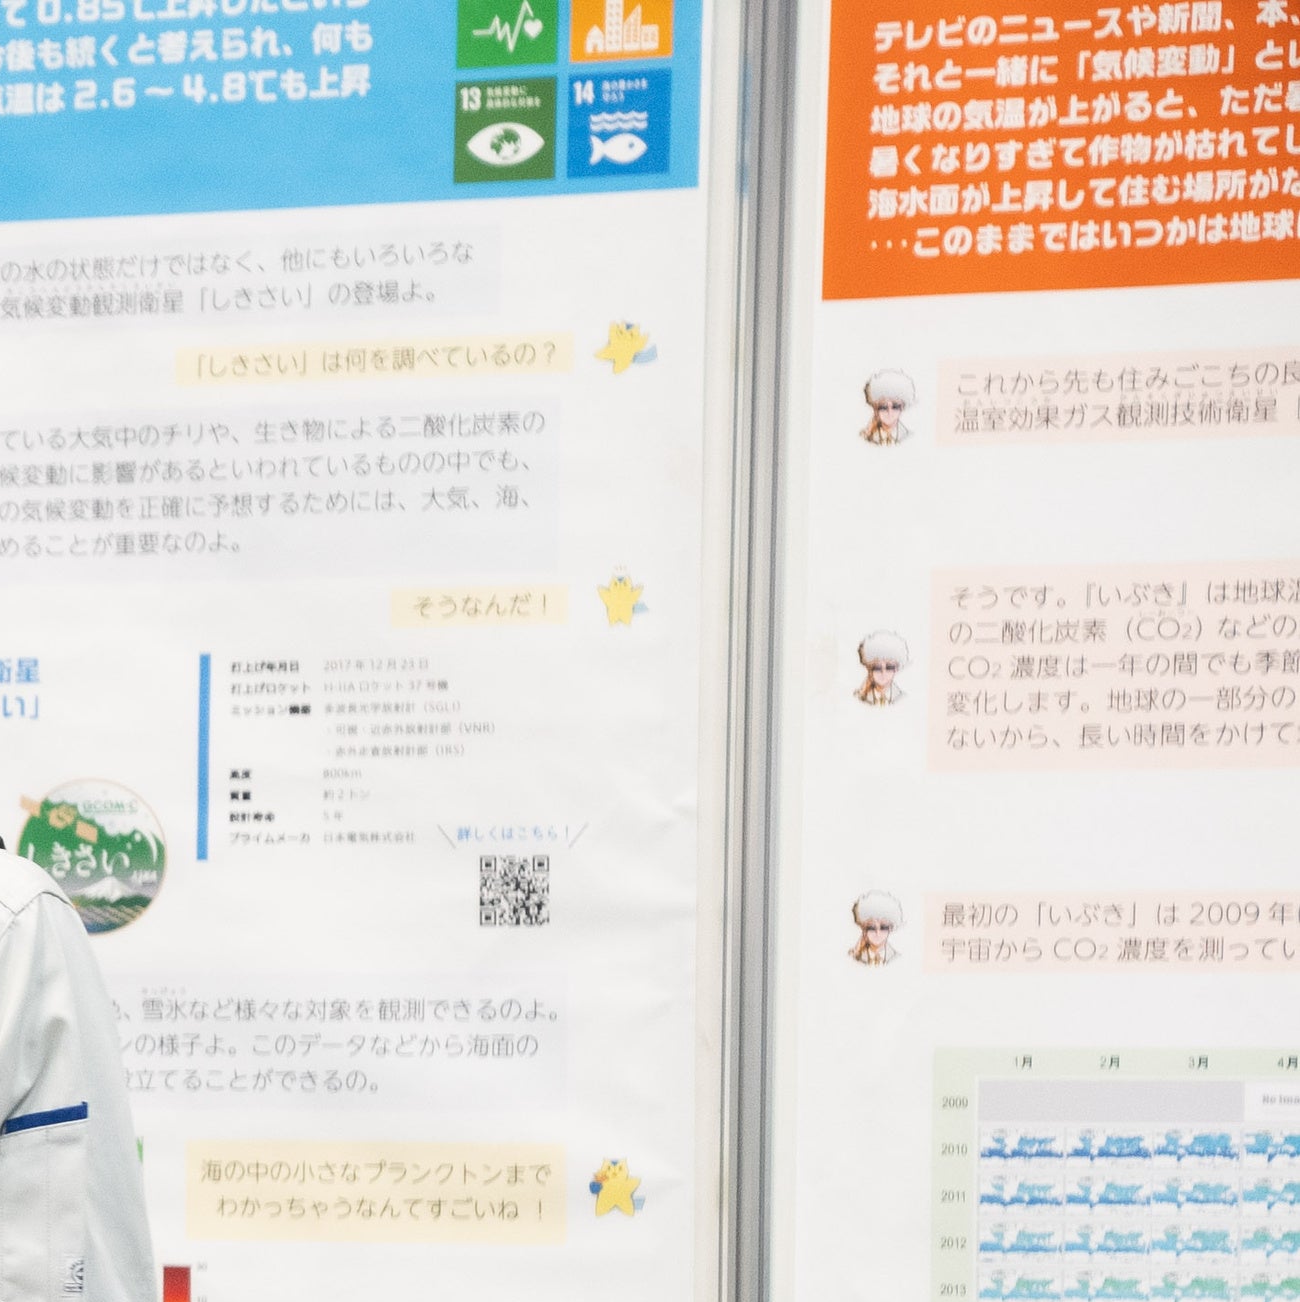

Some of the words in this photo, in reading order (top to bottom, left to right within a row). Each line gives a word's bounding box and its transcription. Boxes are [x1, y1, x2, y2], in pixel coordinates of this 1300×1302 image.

[573, 79, 595, 106] 14
[871, 209, 1300, 258] ・・・このままではいつかは地球
[954, 397, 1300, 434] 温室効果ガス観測技術衛星
[946, 722, 1300, 751] ないから、長い時間をかけて
[941, 901, 1300, 927] 最初の「いぶき」は2009年
